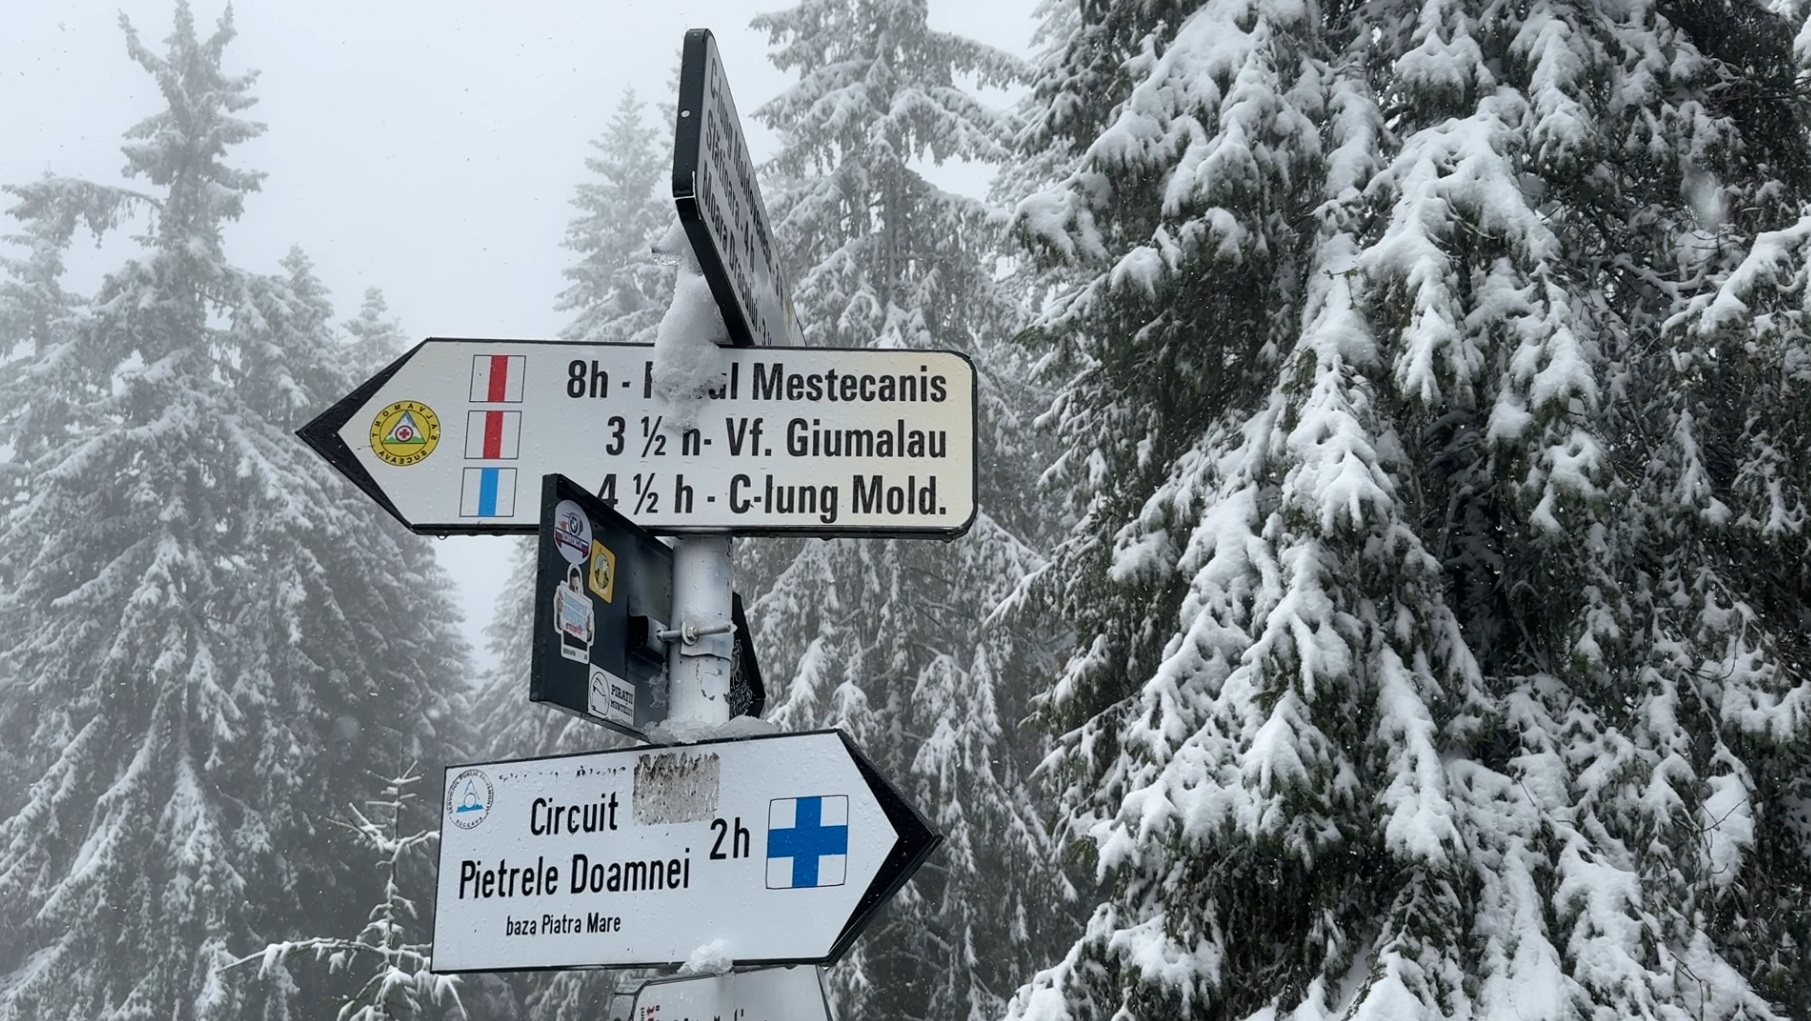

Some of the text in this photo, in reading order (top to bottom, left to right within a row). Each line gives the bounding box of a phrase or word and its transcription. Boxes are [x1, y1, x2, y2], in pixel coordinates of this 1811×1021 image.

[710, 57, 733, 161] C-lung
[702, 159, 728, 255] Moara
[728, 229, 758, 333] Dracului
[566, 359, 609, 399] 8h
[752, 362, 947, 403] Mestecanis
[606, 415, 626, 456] 3
[725, 417, 772, 457] Vf.
[786, 417, 946, 459] Giumalau
[597, 473, 619, 509] 4
[674, 474, 694, 514] h
[729, 473, 839, 524] C-lung
[852, 474, 947, 515] Mold.
[530, 791, 619, 836] Circuit
[459, 847, 691, 900] Pietrele Doamnei
[505, 912, 622, 937] baza Piatra Mare
